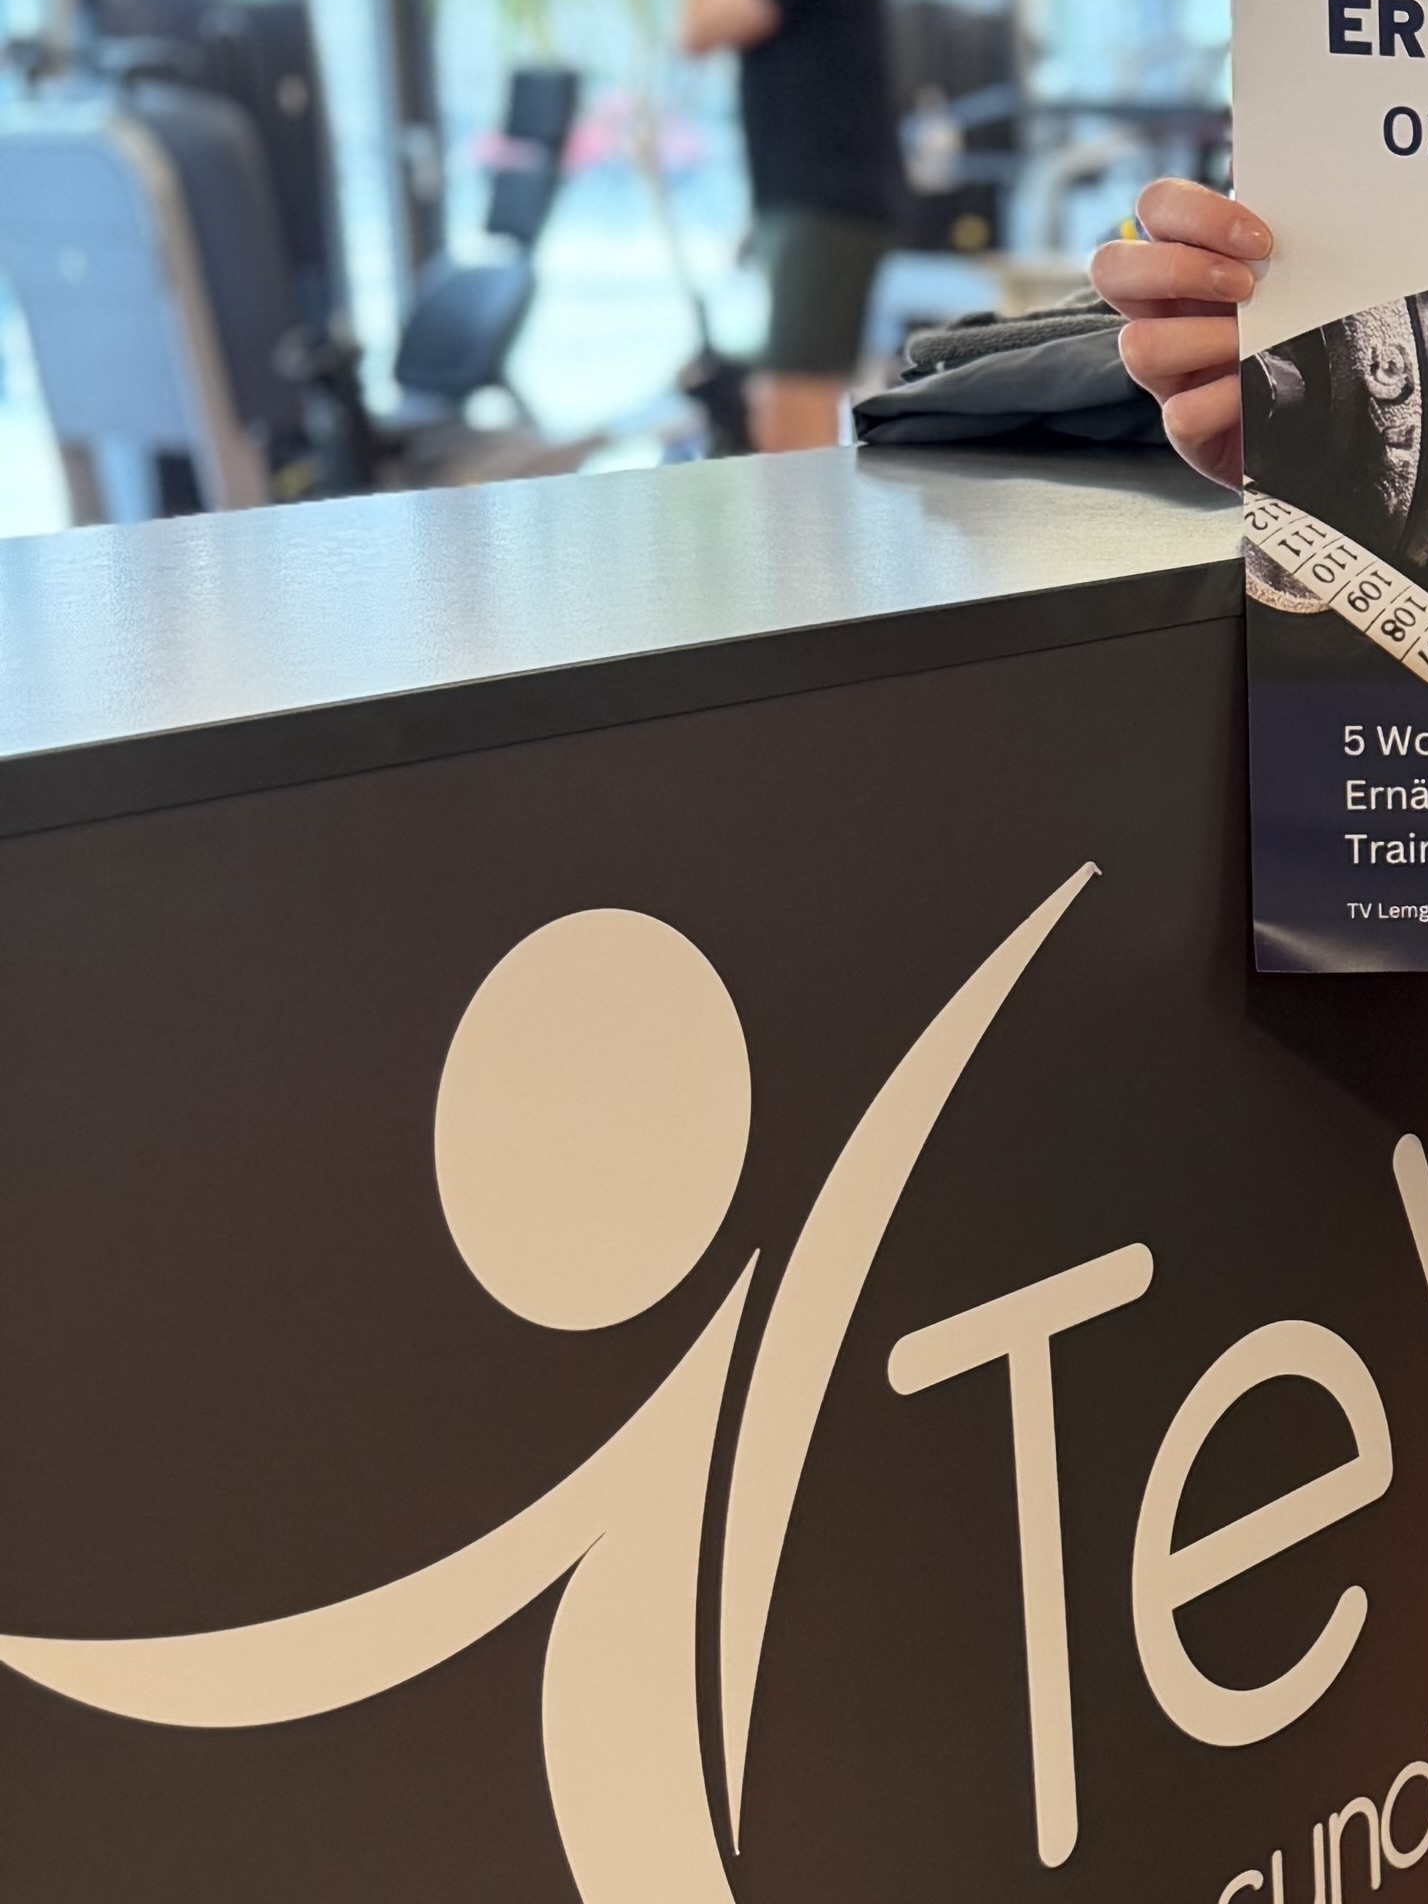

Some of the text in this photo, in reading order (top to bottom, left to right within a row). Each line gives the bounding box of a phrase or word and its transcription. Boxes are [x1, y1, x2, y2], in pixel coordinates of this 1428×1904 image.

[1278, 523, 1328, 557] 111
[1312, 544, 1358, 584] 110
[1347, 570, 1393, 614] 109
[1380, 596, 1427, 642] 108
[1345, 726, 1364, 755] 5
[1347, 903, 1372, 918] TV
